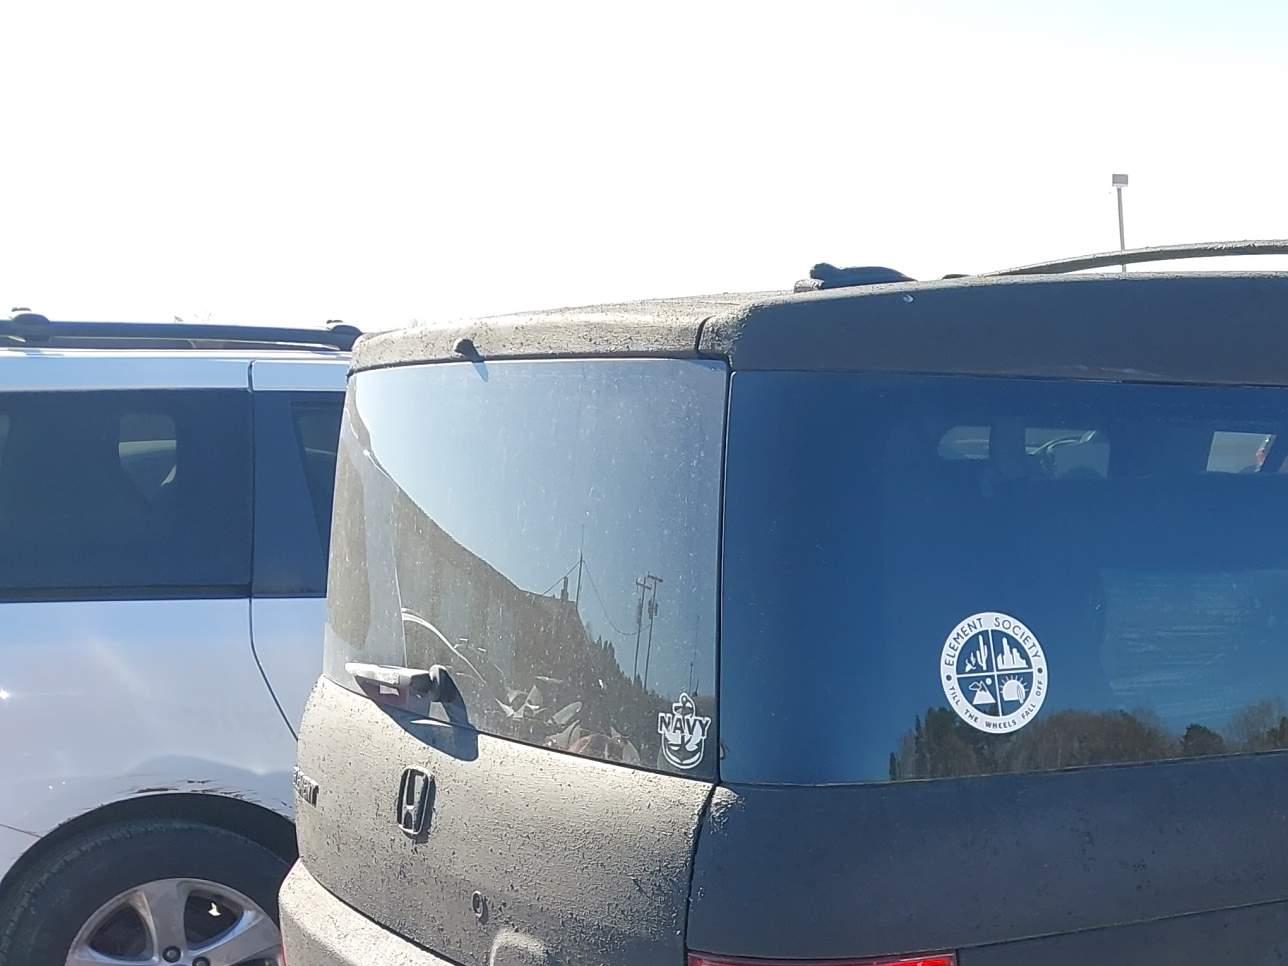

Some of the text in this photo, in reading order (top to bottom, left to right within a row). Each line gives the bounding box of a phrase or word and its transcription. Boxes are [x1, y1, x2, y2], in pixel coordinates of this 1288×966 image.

[945, 617, 1041, 667] ELEMENT SOCIETY
[659, 713, 711, 738] NAVY
[949, 680, 1044, 729] TILL THE WHEELS FALL OFF
